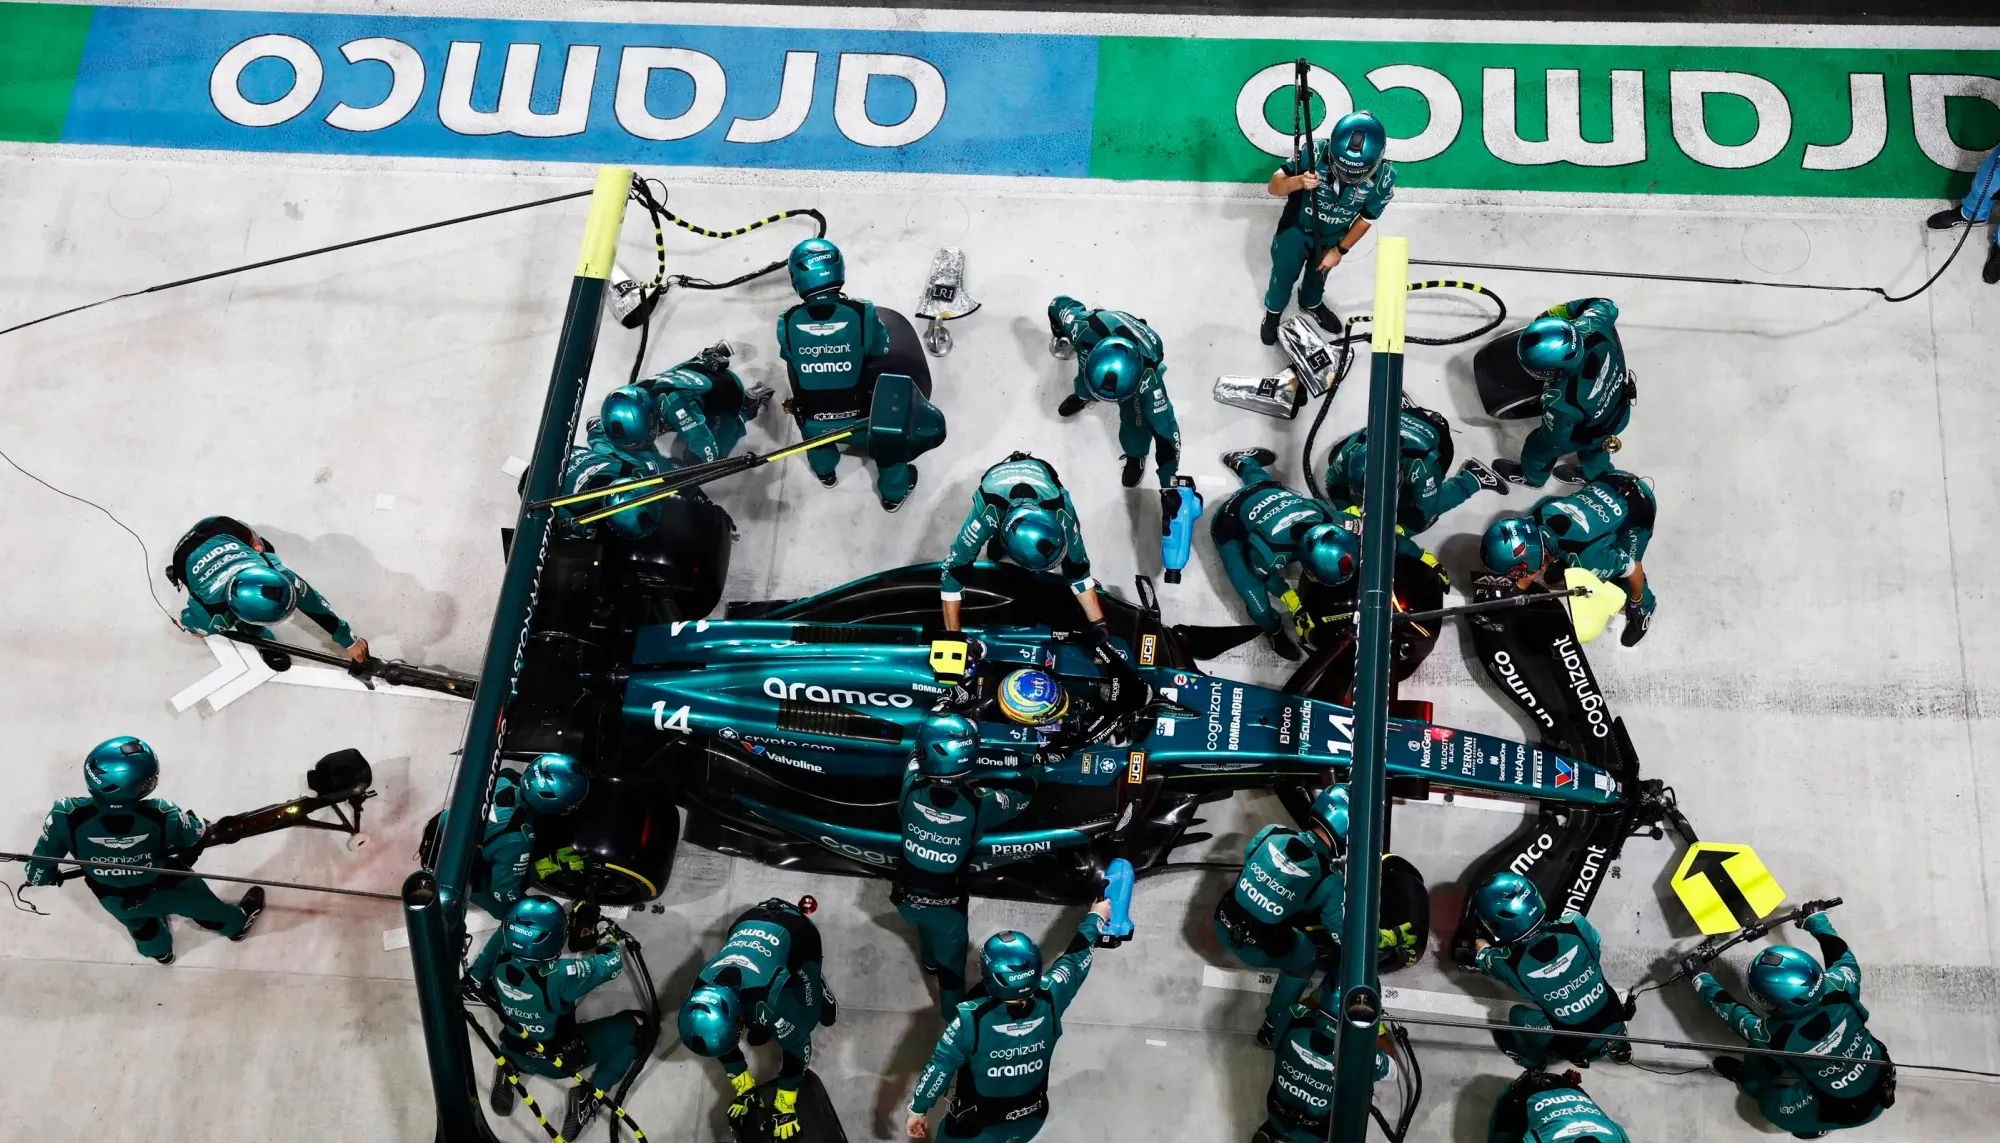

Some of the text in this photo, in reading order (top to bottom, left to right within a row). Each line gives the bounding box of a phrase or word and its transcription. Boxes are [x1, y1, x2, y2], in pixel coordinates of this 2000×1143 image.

[209, 33, 947, 148] aramco
[1338, 156, 1364, 167] aramco
[807, 253, 832, 265] aramco
[932, 288, 954, 300] LR1
[799, 343, 851, 358] cognizant
[1310, 352, 1329, 370] LF1
[801, 361, 852, 373] aramco
[1261, 378, 1276, 397] LF2
[1248, 492, 1293, 520] aramco
[192, 542, 240, 575] aramco
[1096, 647, 1111, 664] aramco
[1142, 637, 1153, 663] JCB
[763, 677, 913, 708] aramco
[1177, 675, 1185, 684] N
[1552, 634, 1608, 738] cognizant
[651, 700, 693, 735] 14
[1207, 682, 1223, 751] cognizant
[1228, 687, 1243, 751] BOMBARDIER
[1281, 706, 1292, 735] Porto
[744, 735, 836, 752] cryptocom
[1327, 714, 1355, 755] 14
[765, 751, 823, 773] Valvoline
[1420, 729, 1431, 768] NexGen
[1441, 728, 1451, 770] VELOCITY
[1462, 736, 1474, 776] PERONI
[1499, 743, 1507, 781] SentinelOne
[1131, 754, 1141, 781] JCB
[1514, 745, 1525, 785] NetApp
[1532, 749, 1543, 789] PIRELLI
[907, 822, 962, 847] cognizant
[90, 852, 153, 865] cognizant
[905, 839, 957, 864] aramco
[991, 841, 1051, 856] PERONI
[1510, 833, 1553, 876] mco
[1250, 862, 1296, 901] cognizant
[1560, 844, 1607, 919] gnizant
[1239, 877, 1284, 916] aramco
[509, 924, 533, 937] aramco
[1008, 969, 1036, 982] aramco
[1543, 965, 1595, 1002] cognizant
[502, 1004, 541, 1020] gnizant
[1554, 983, 1604, 1018] aramco
[989, 1040, 1046, 1060] cognizant
[987, 1058, 1043, 1078] aramco
[1277, 1074, 1328, 1109] aramco
[1534, 1094, 1593, 1112] aramco
[1541, 1104, 1601, 1124] cognizant
